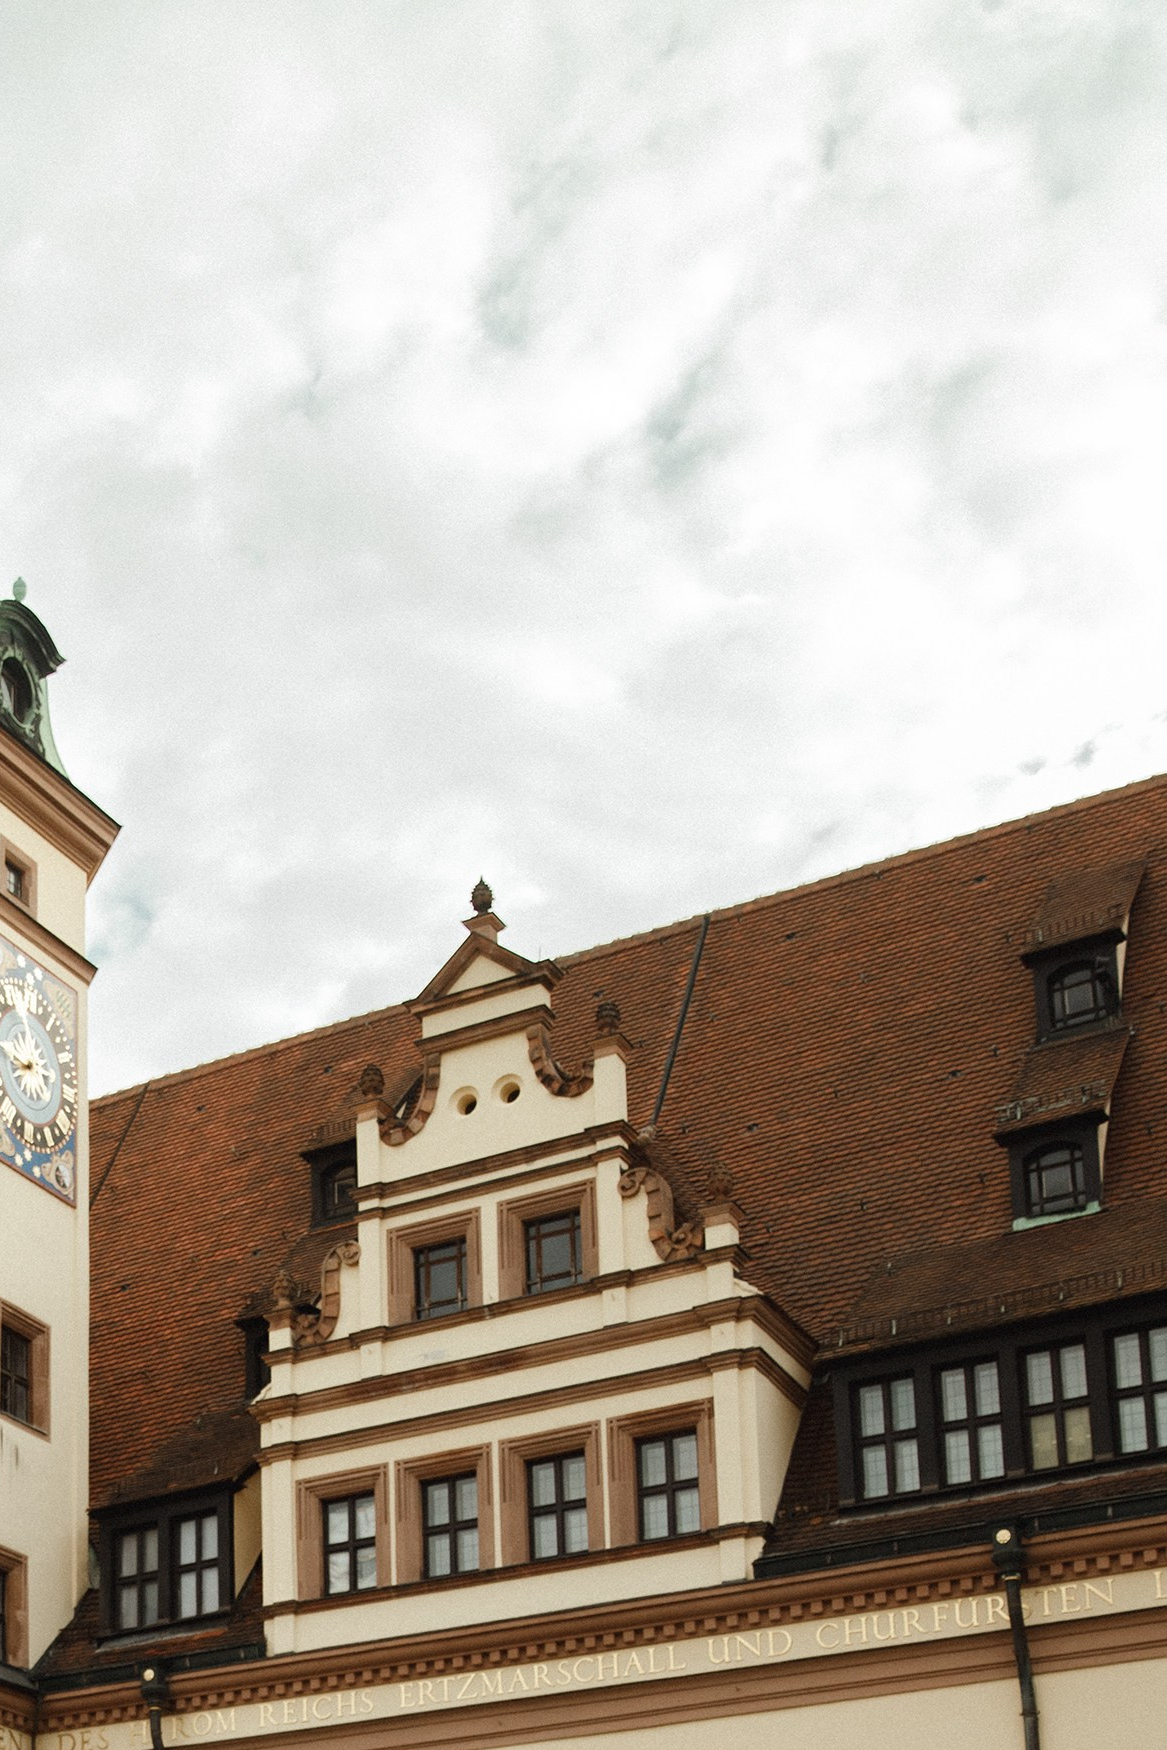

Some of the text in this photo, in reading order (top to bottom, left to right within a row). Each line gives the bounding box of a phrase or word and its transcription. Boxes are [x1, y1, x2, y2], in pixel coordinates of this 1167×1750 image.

[171, 1707, 237, 1741] ROM
[258, 1690, 374, 1728] REICHS
[399, 1645, 686, 1708] ERTZMARSCHALL
[707, 1629, 794, 1666] UND
